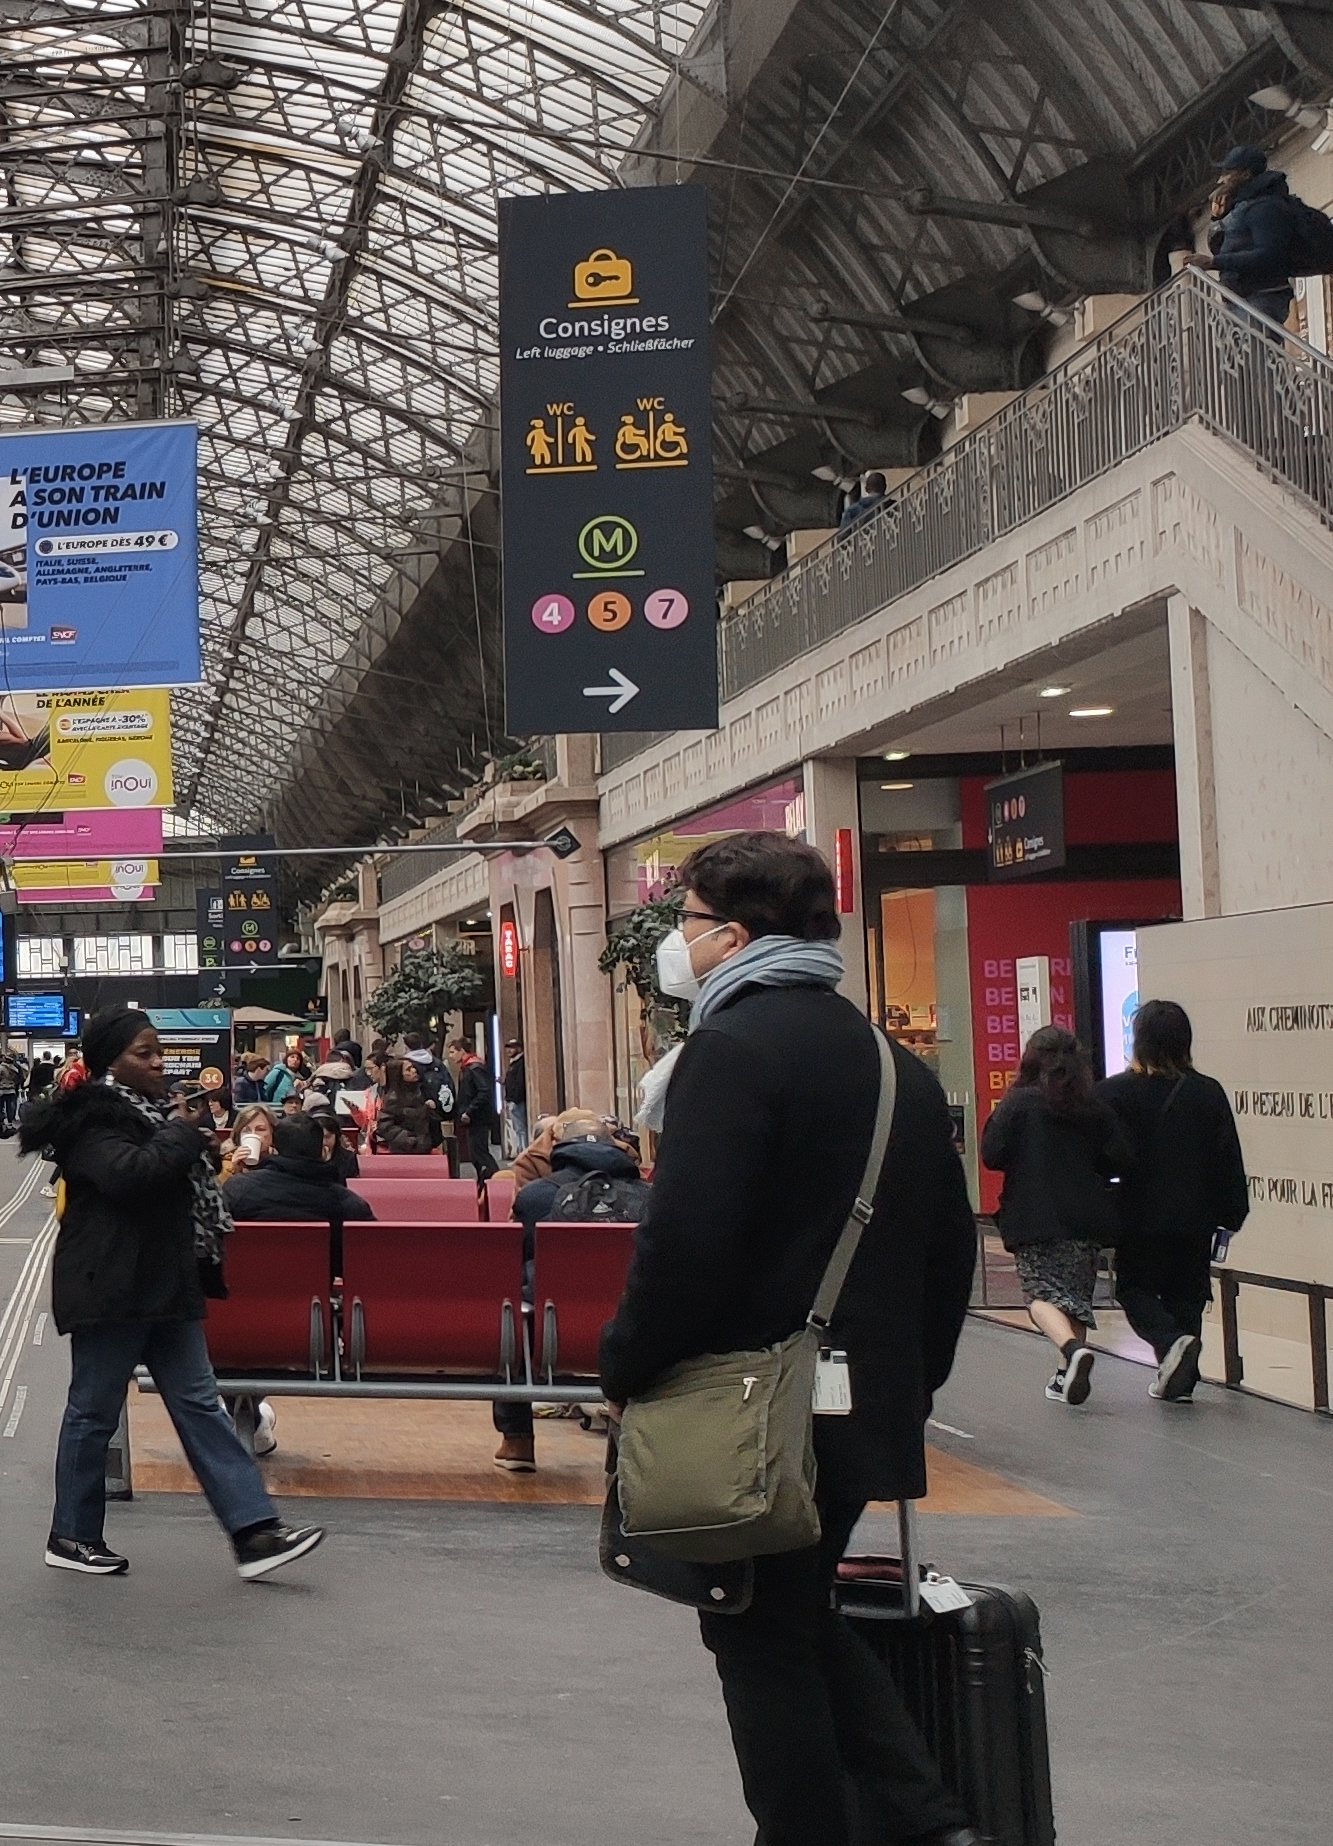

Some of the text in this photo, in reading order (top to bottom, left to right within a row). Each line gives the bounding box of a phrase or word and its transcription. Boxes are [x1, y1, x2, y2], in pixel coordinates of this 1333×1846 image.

[539, 314, 670, 340] Consignes
[515, 337, 694, 361] Left luggage Schließfächer
[547, 403, 574, 416] WC
[637, 398, 665, 410] WC
[10, 462, 126, 485] L'EUROPE
[9, 482, 165, 507] A SON TRAIN
[11, 507, 119, 529] D'UNION
[58, 540, 108, 550] L'EUROPE
[111, 537, 131, 547] DÈS
[134, 535, 155, 547] 49
[595, 528, 623, 556] M
[542, 598, 675, 625] 4 5 7
[36, 696, 105, 708] DE L'ANNÉE
[984, 960, 1012, 978] BE
[986, 988, 1014, 1005] BE
[987, 1015, 1015, 1033] BE
[1247, 1006, 1266, 1032] AUX
[988, 1043, 1017, 1061] BE
[1234, 1091, 1248, 1115] DU
[1299, 1093, 1315, 1118] DE
[1268, 1178, 1297, 1204] POUR
[1302, 1181, 1317, 1207] LA
